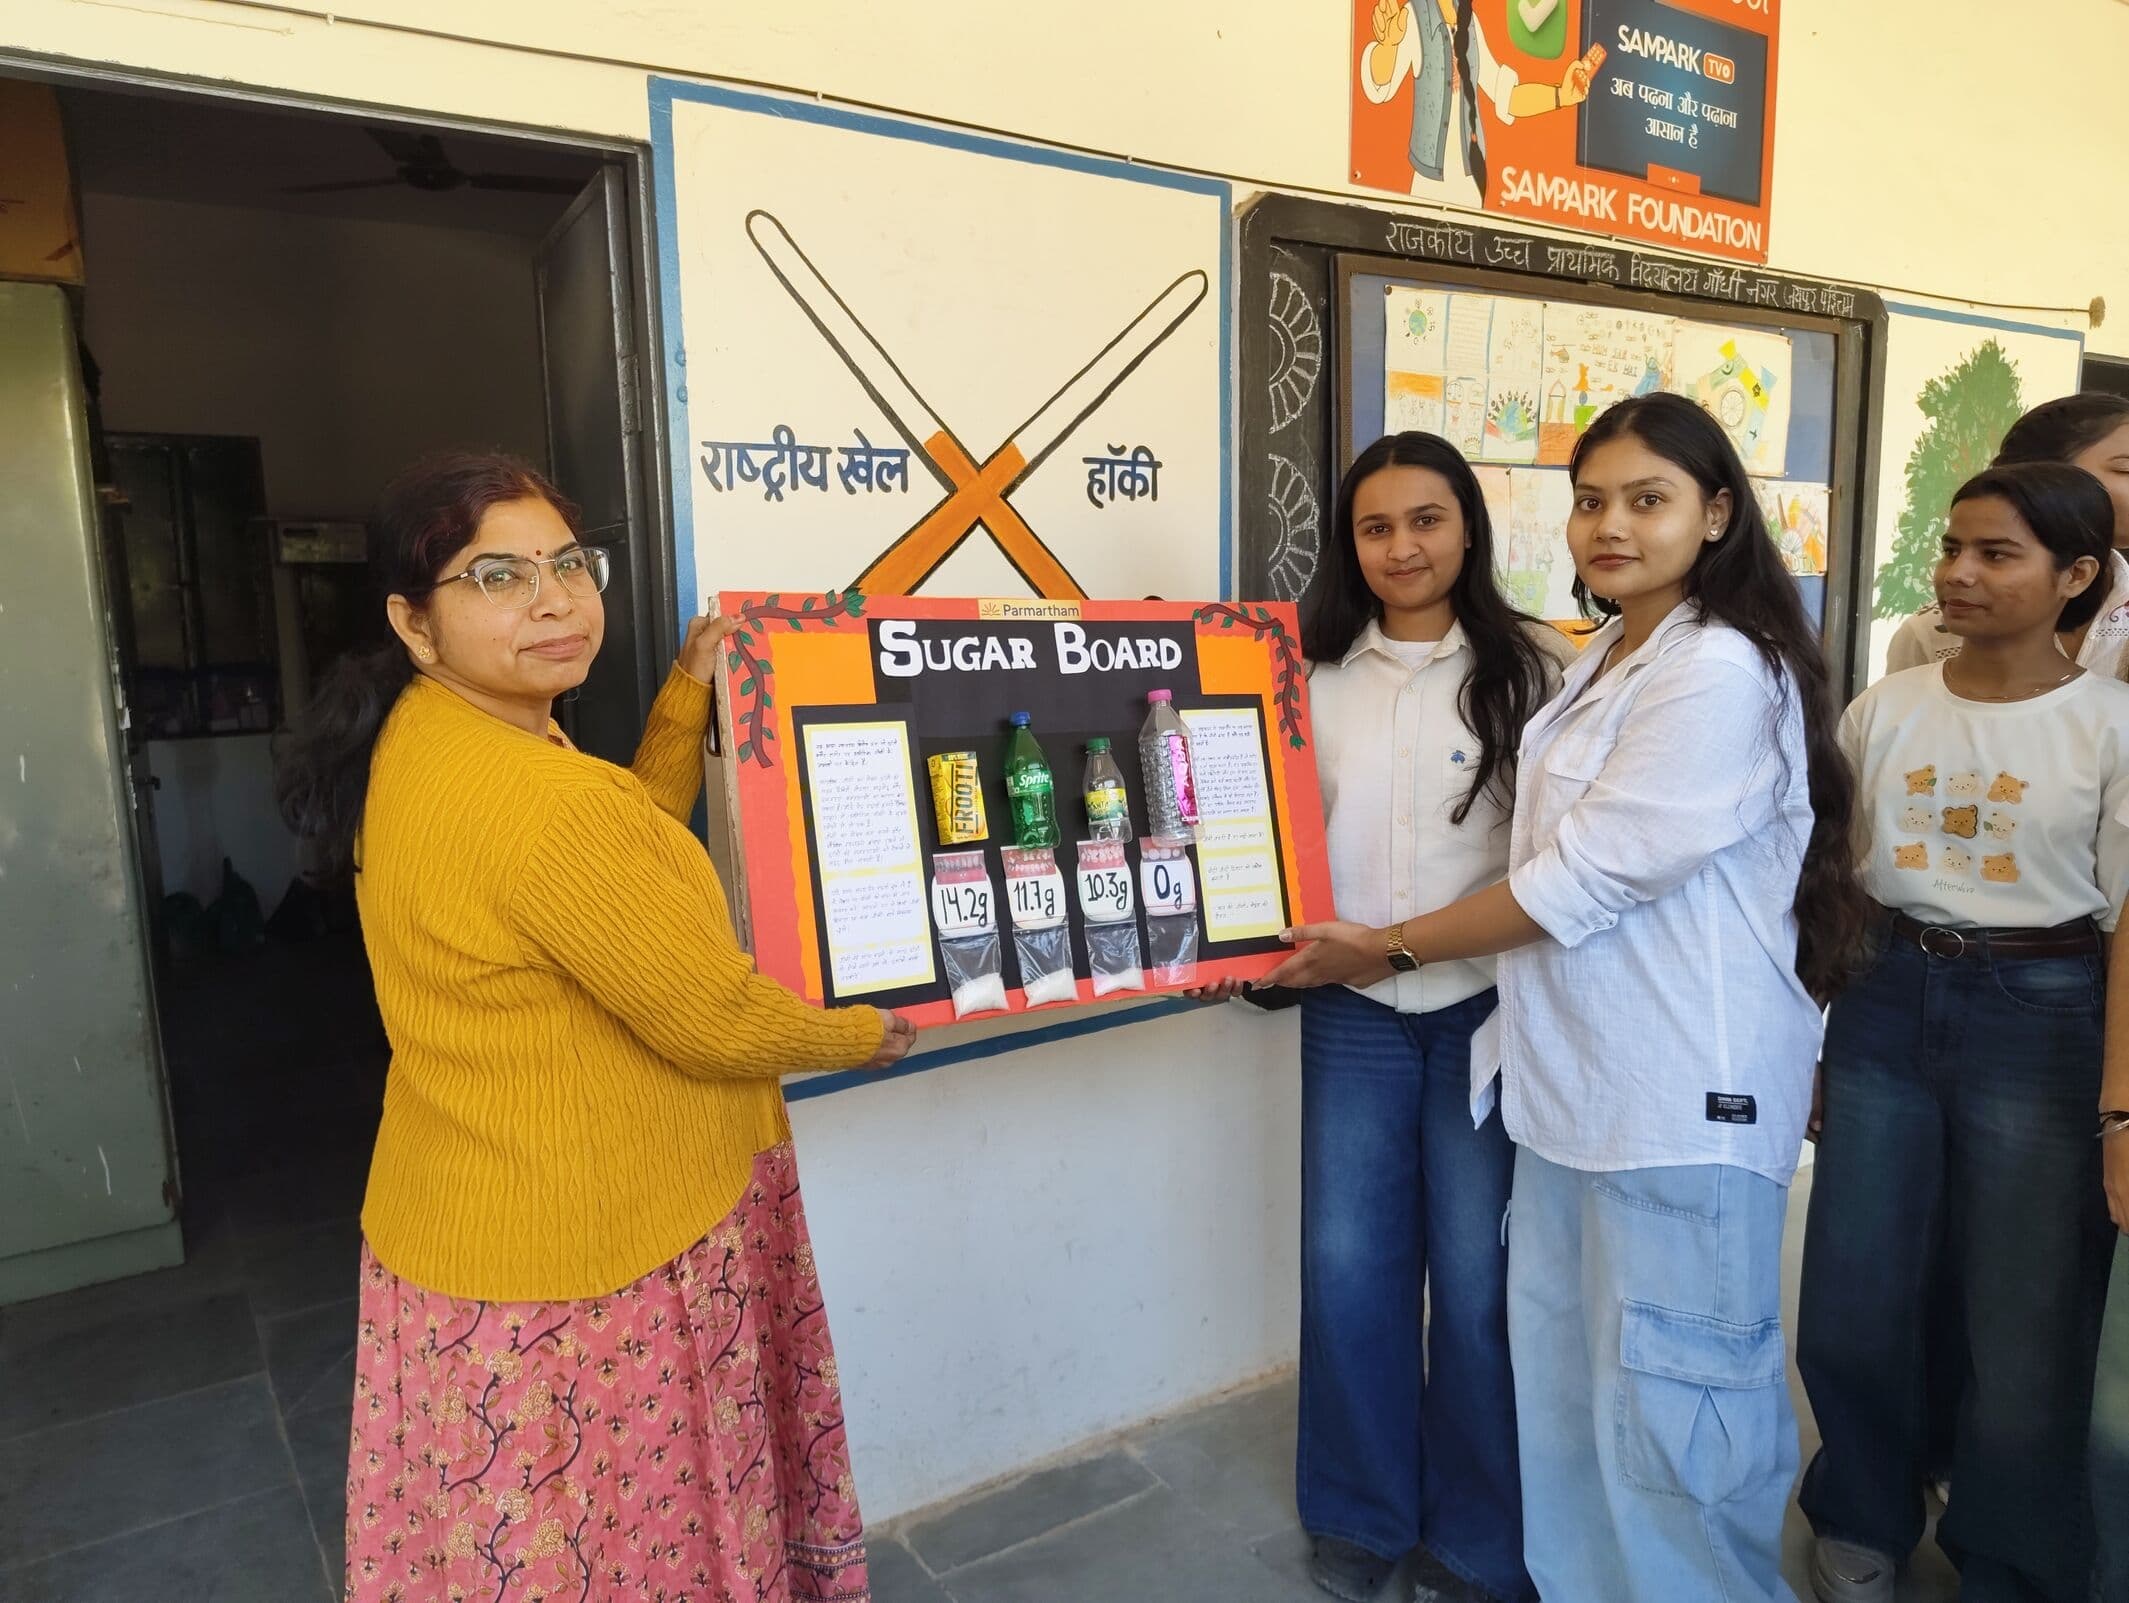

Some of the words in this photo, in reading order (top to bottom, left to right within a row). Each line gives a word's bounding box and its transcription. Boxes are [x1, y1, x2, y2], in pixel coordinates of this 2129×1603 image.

[1617, 24, 1701, 74] SAMPARK
[1610, 77, 1634, 99] अब
[1638, 83, 1673, 110] पढ़ना
[1677, 91, 1698, 118] और
[1701, 103, 1738, 129] पढ़ाना
[1645, 117, 1685, 144] आसान
[1688, 123, 1699, 149] है
[1501, 166, 1618, 221] SAMPARK
[1628, 193, 1761, 251] FOUNDATION
[1385, 220, 1475, 263] राजकीय
[1484, 235, 1534, 271] उच्च
[1547, 245, 1619, 281] प्राथमिक
[1747, 278, 1779, 308] नगर
[700, 424, 832, 502] राष्ट्रीय
[837, 427, 910, 495] खेल
[1082, 442, 1163, 509] हॉकी
[1003, 604, 1079, 617] Parmartham
[879, 620, 1037, 677] SUGAR
[1054, 622, 1182, 674] BOARD
[955, 764, 974, 833] FROOTI
[1019, 771, 1049, 788] Sprite
[941, 887, 987, 927] 14.2g
[1013, 880, 1054, 917] 11.7g
[1085, 872, 1127, 910] 10.3g
